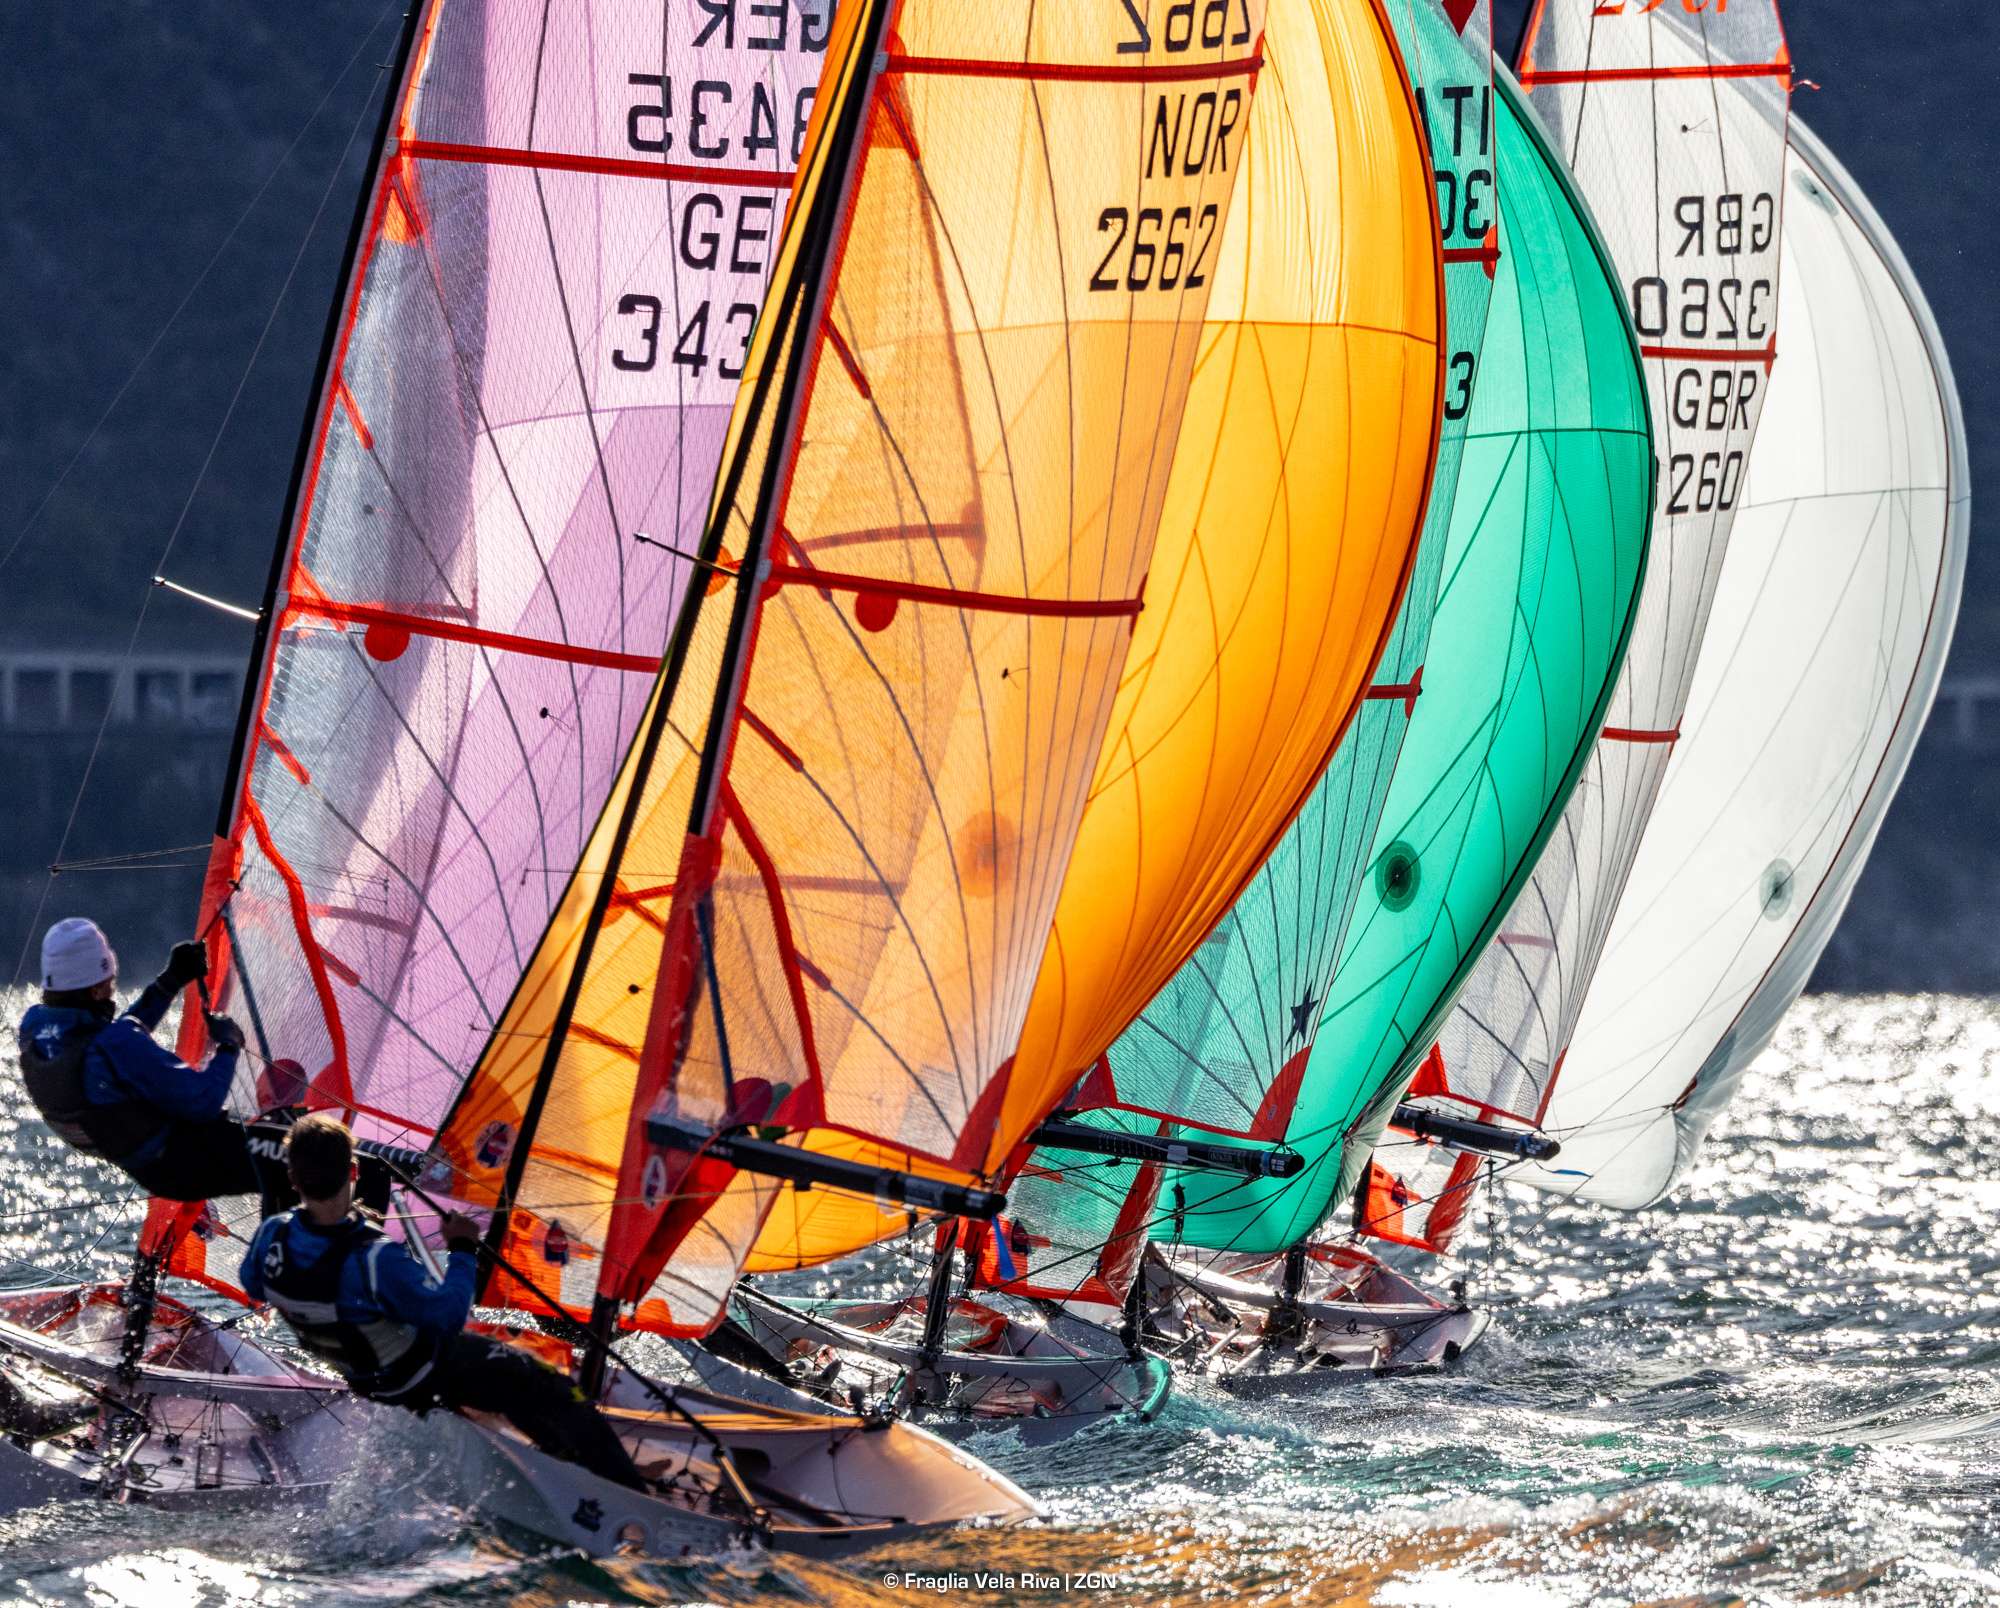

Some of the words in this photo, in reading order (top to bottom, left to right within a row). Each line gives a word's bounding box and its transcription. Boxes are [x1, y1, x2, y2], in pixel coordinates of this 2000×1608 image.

[1145, 88, 1241, 180] NOR
[680, 192, 773, 274] GE
[1089, 204, 1218, 292] 2662
[612, 293, 760, 380] 343
[1444, 351, 1475, 421] 3
[1672, 368, 1758, 431] GBR
[1655, 450, 1744, 516] 260
